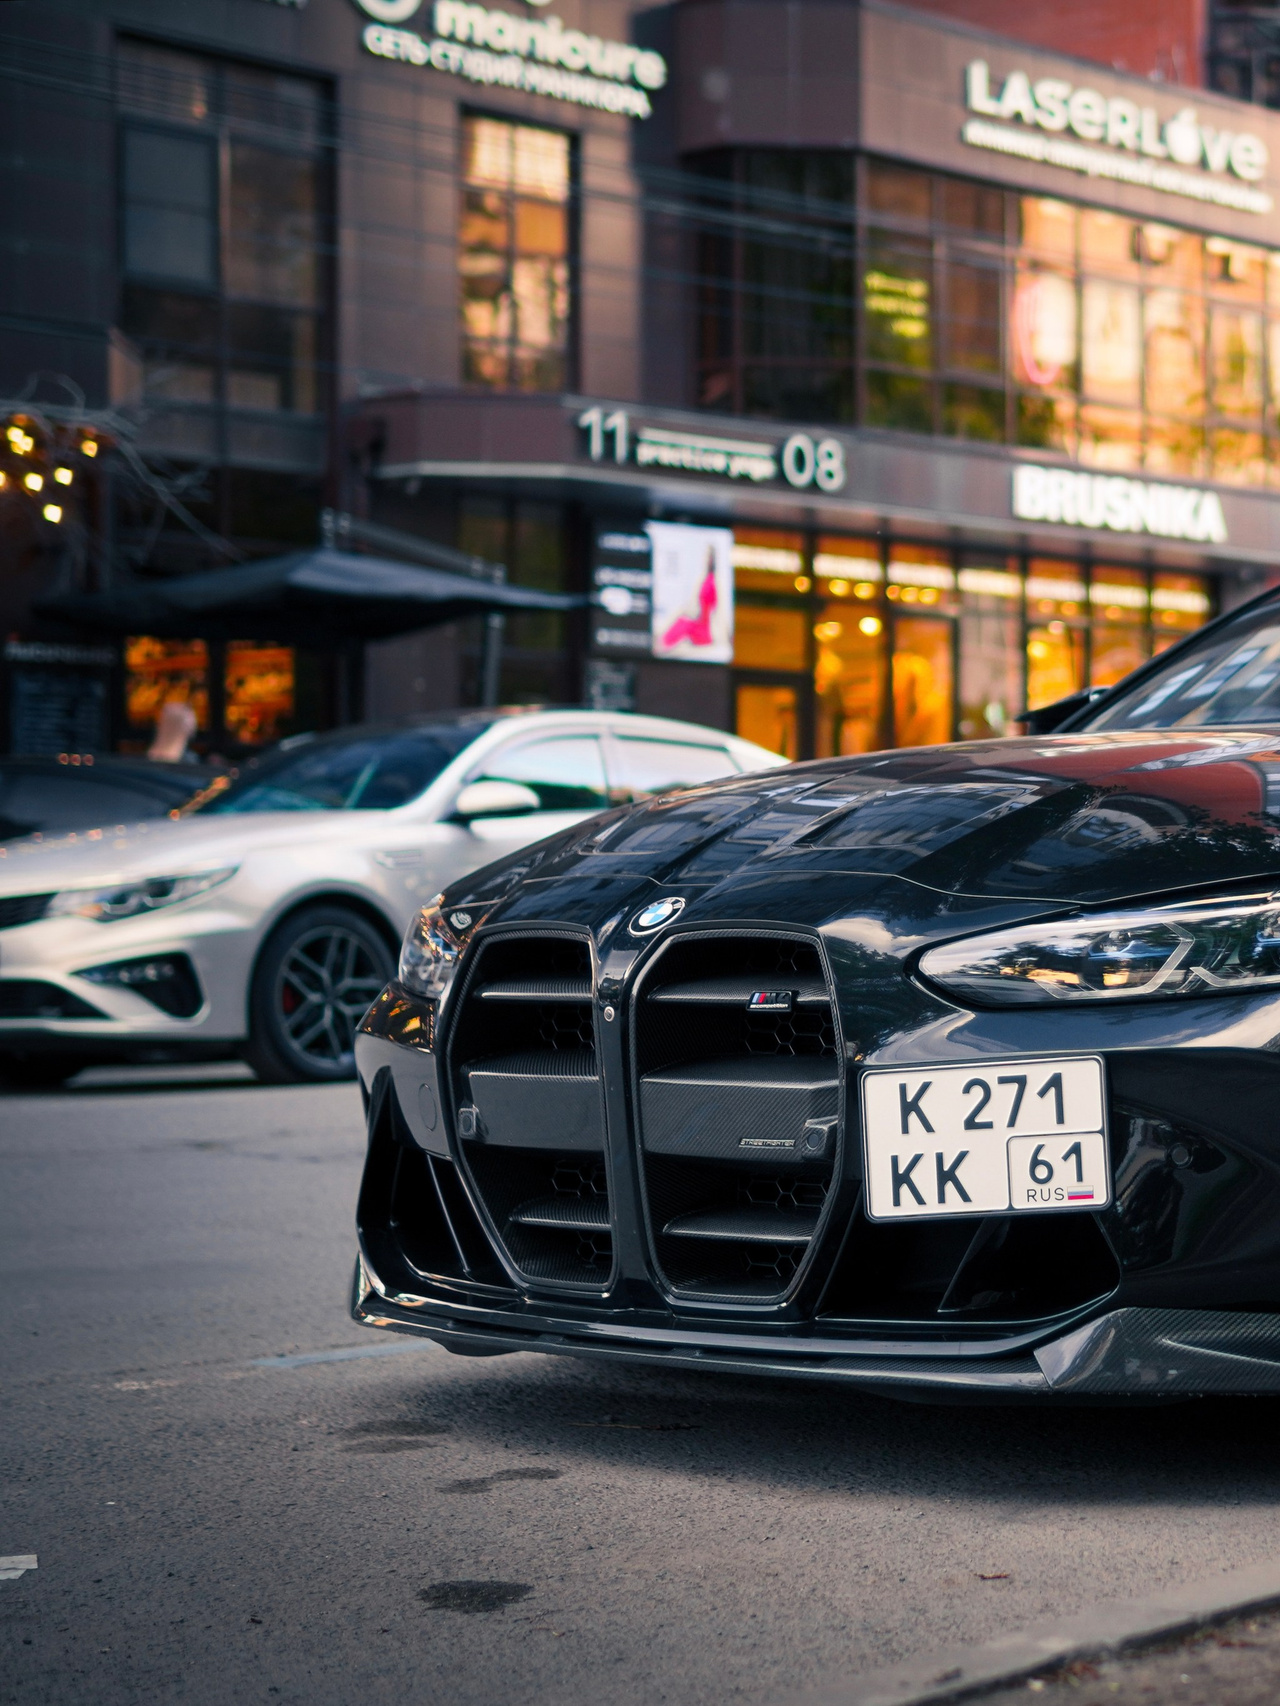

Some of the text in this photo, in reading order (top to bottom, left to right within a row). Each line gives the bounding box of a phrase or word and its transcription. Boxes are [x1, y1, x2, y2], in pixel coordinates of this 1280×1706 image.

[363, 23, 430, 66] СЕТЬ
[434, 0, 667, 90] manicure
[578, 406, 629, 464] 11
[782, 432, 846, 493] 08
[1012, 463, 1228, 544] BRUSNIKA
[898, 1071, 1065, 1135] K 271
[890, 1150, 973, 1207] KK
[1028, 1141, 1083, 1185] 61
[1026, 1187, 1065, 1203] RUS
